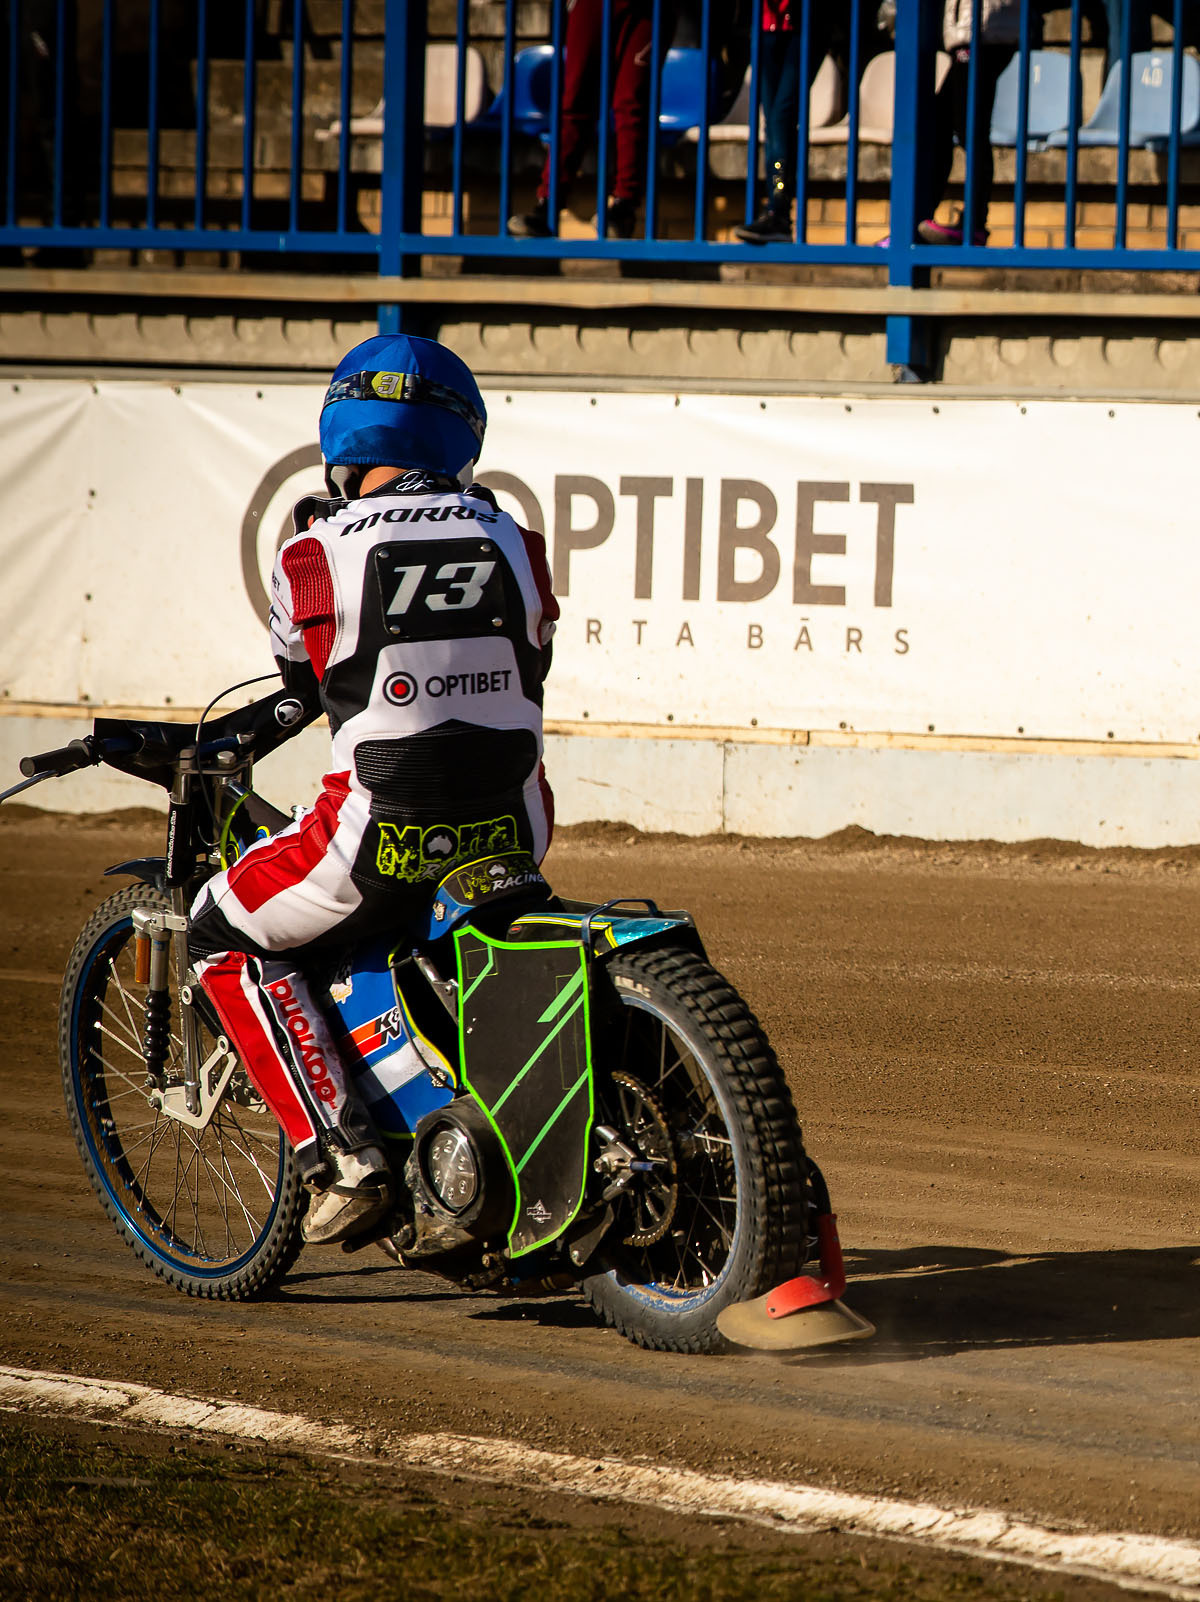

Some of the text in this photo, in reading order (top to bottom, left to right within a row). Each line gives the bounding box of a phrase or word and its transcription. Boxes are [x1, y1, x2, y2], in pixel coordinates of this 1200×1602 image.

[340, 505, 499, 537] MORRIS
[386, 561, 496, 616] 13
[747, 618, 911, 656] BĀRS
[425, 670, 512, 698] OPTIBET
